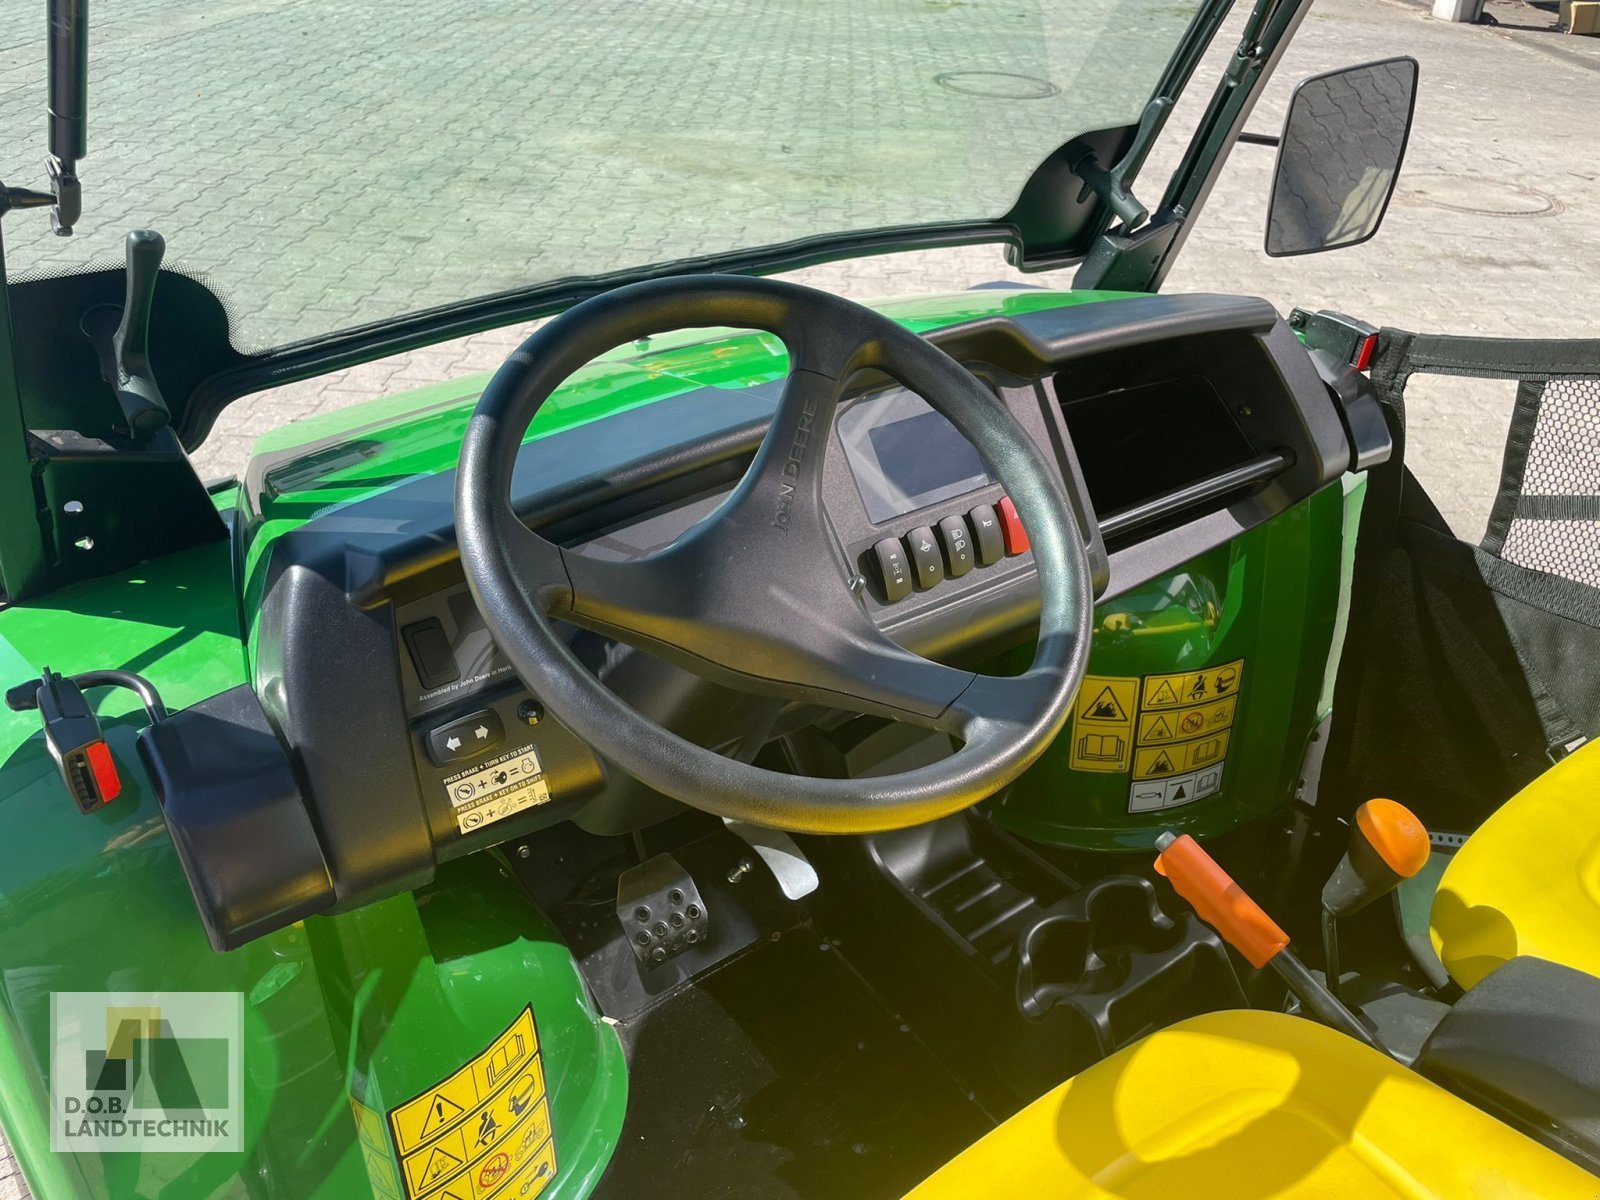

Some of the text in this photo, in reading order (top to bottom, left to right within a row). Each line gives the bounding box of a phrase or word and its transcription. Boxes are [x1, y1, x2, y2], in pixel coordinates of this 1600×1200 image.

[419, 685, 451, 702] Assembled
[451, 683, 459, 691] by
[460, 678, 474, 687] John
[475, 672, 491, 682] Deere
[443, 773, 462, 785] PRESS
[462, 766, 479, 778] BRAKE
[484, 758, 500, 768] TURN
[499, 754, 510, 763] KEY
[510, 751, 518, 759] TO
[518, 744, 534, 756] START
[457, 800, 476, 813] PRESS
[476, 794, 494, 805] BRAKE
[499, 788, 511, 796] KEY
[510, 784, 519, 792] ON
[526, 775, 542, 784] SHIFT
